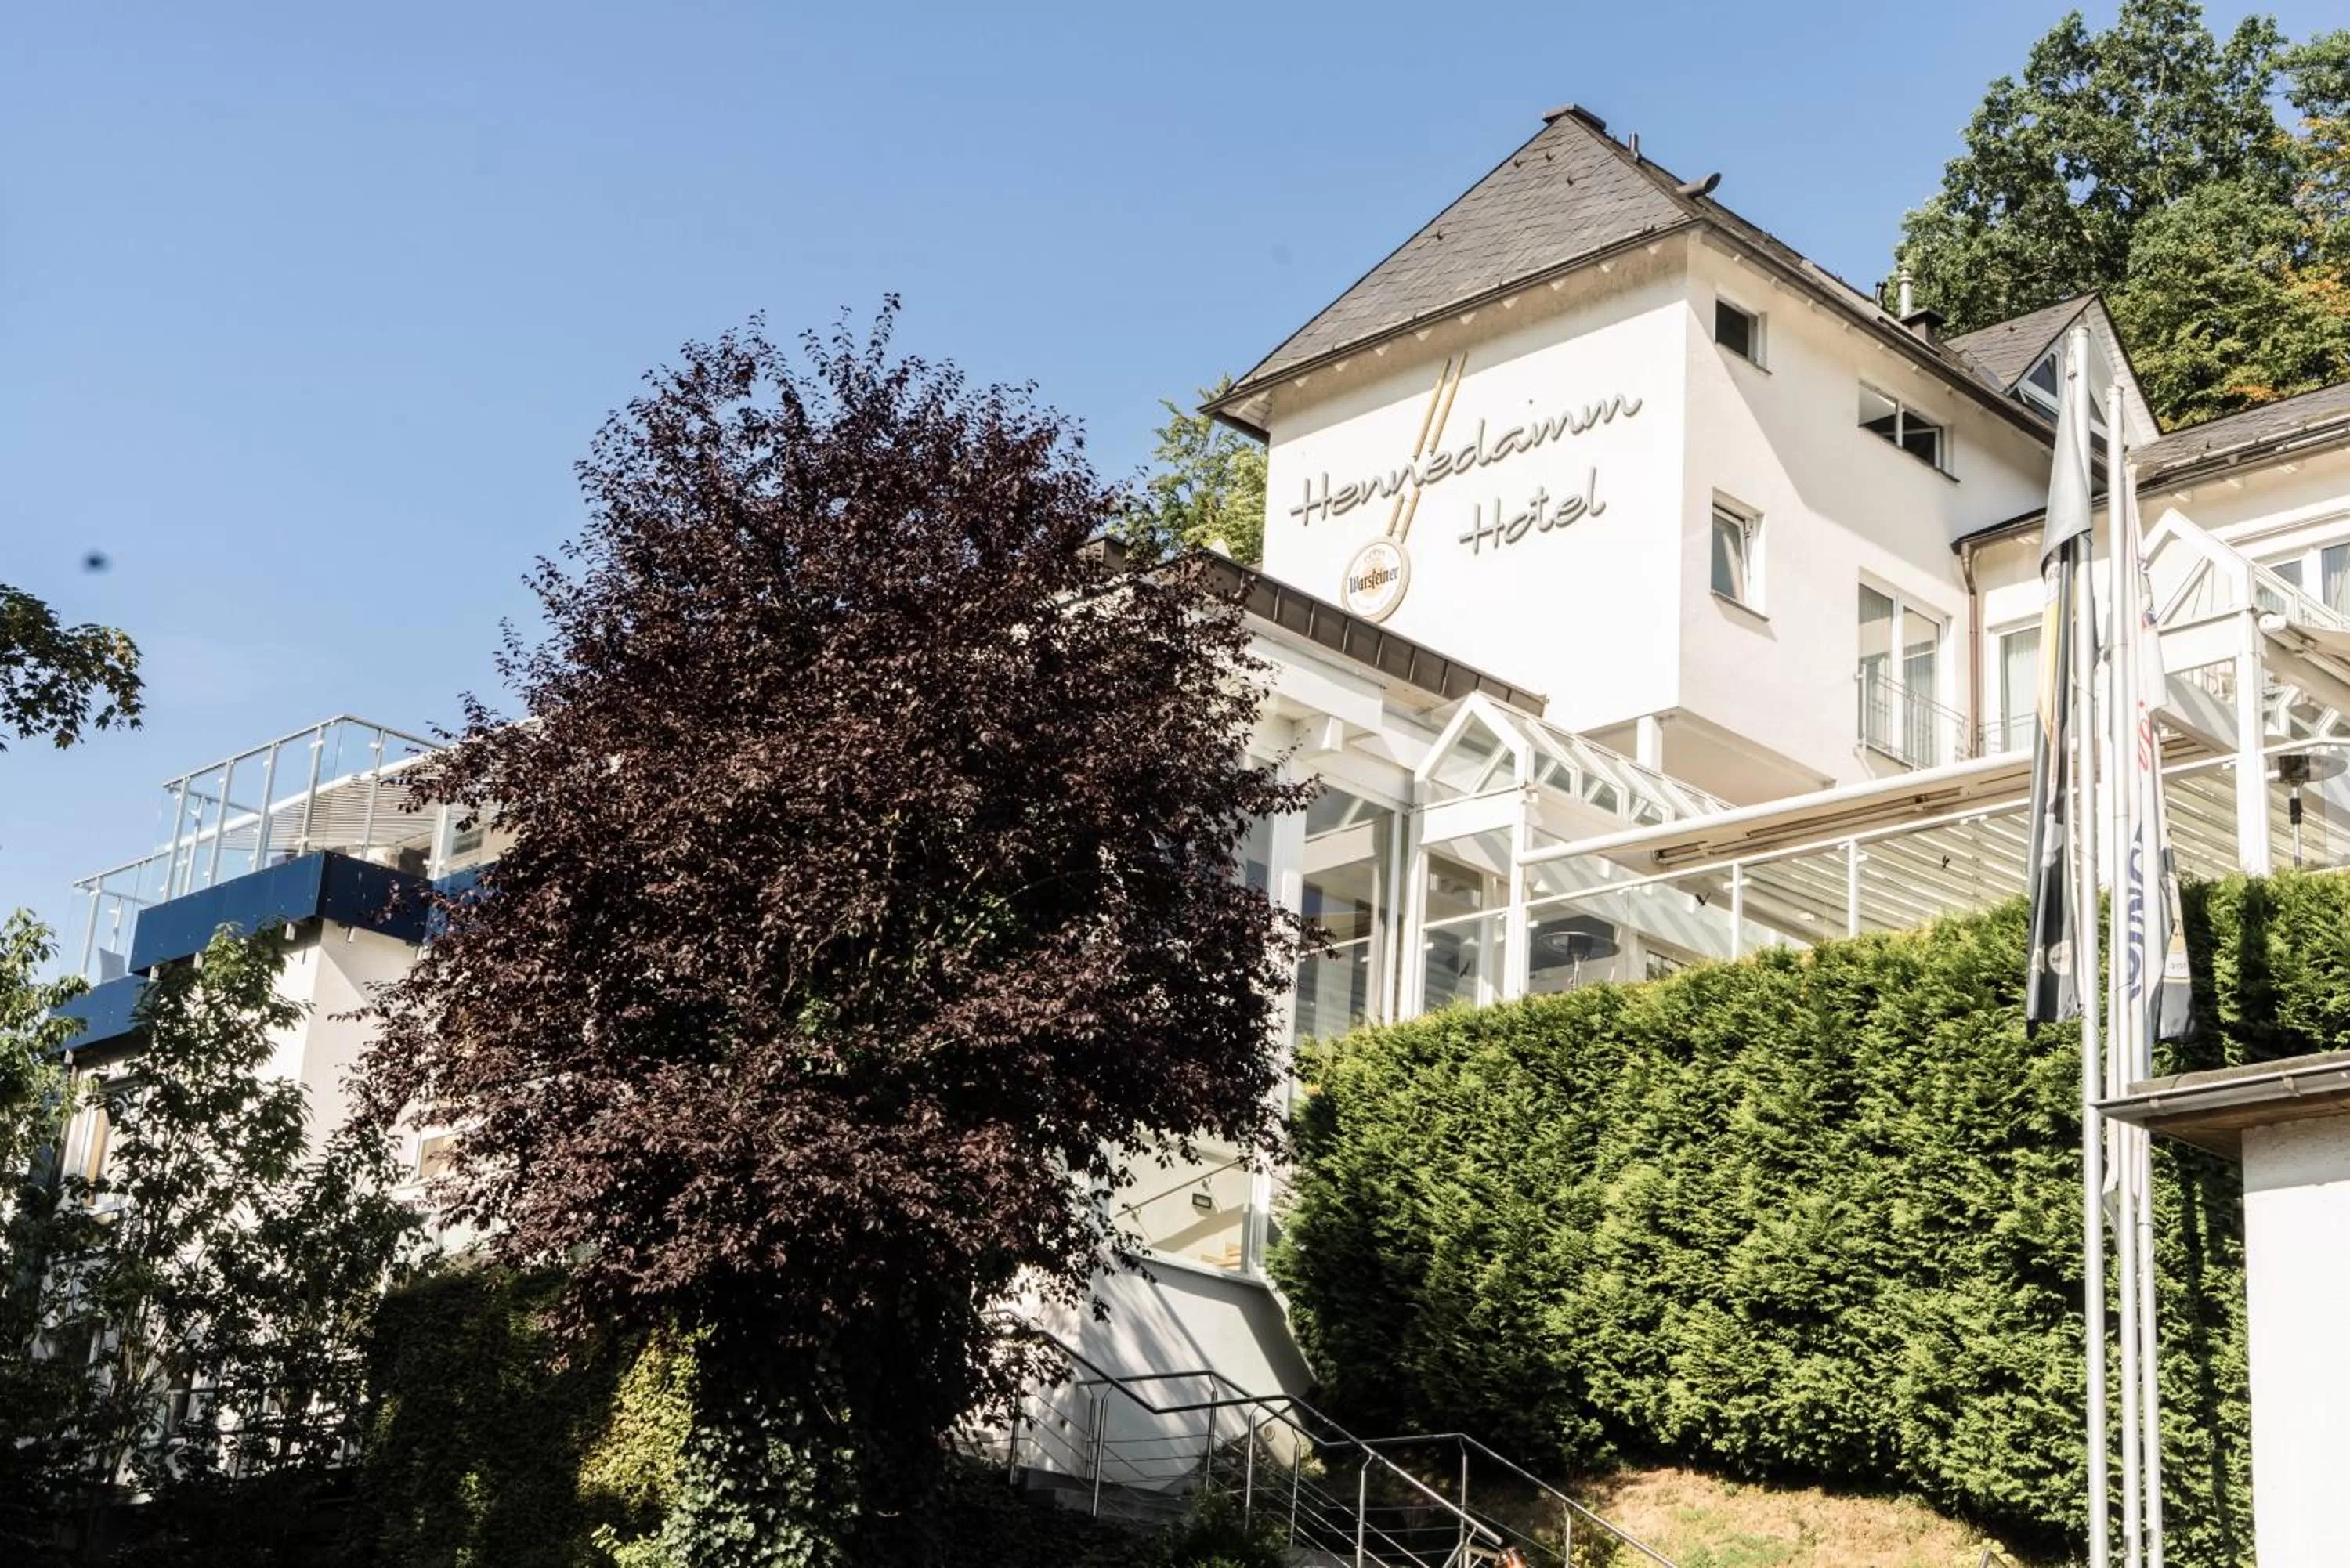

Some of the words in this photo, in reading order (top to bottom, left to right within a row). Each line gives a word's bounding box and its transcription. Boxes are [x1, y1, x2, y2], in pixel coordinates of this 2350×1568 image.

[1289, 392, 1643, 526] Hennedamm
[1459, 467, 1607, 555] Hotel
[1350, 566, 1400, 594] Warsteiner
